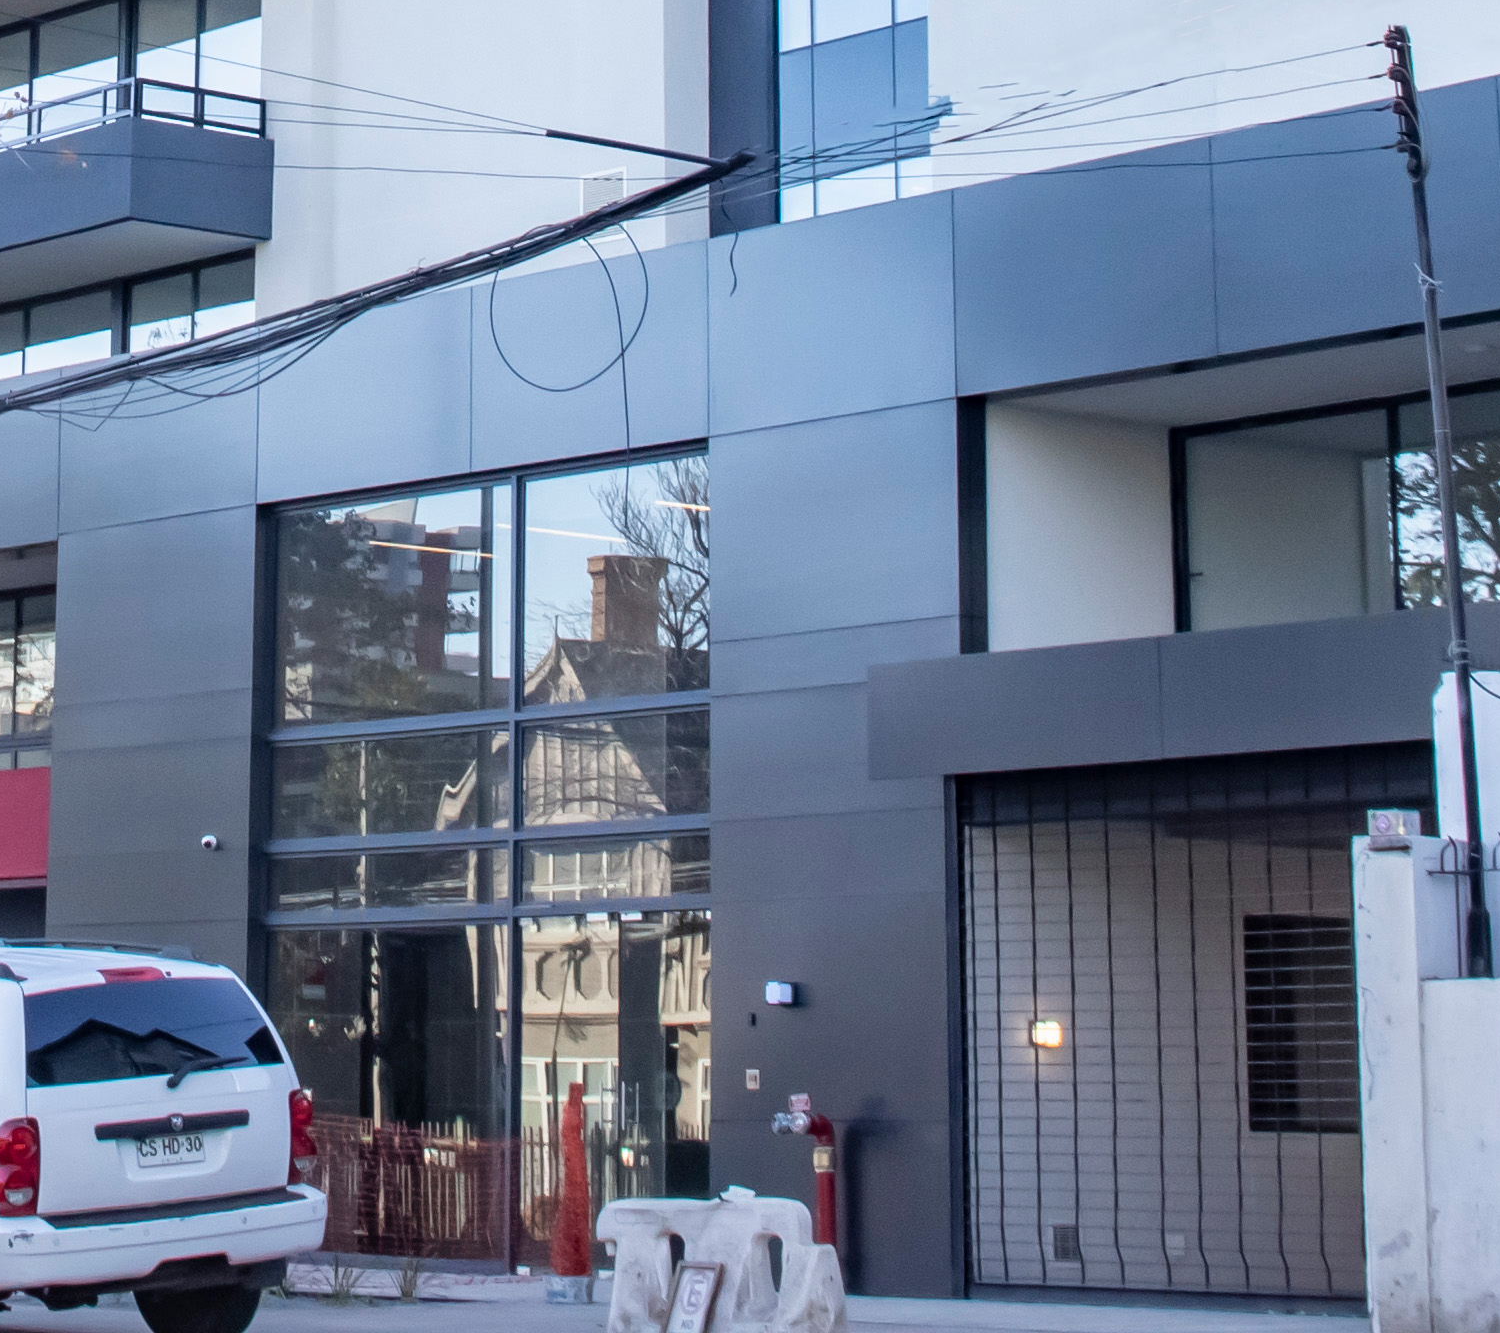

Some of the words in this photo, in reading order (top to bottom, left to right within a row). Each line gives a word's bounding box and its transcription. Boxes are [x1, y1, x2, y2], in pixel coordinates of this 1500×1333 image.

[140, 1139, 158, 1157] CS
[162, 1137, 180, 1156] HD
[185, 1135, 203, 1152] 30
